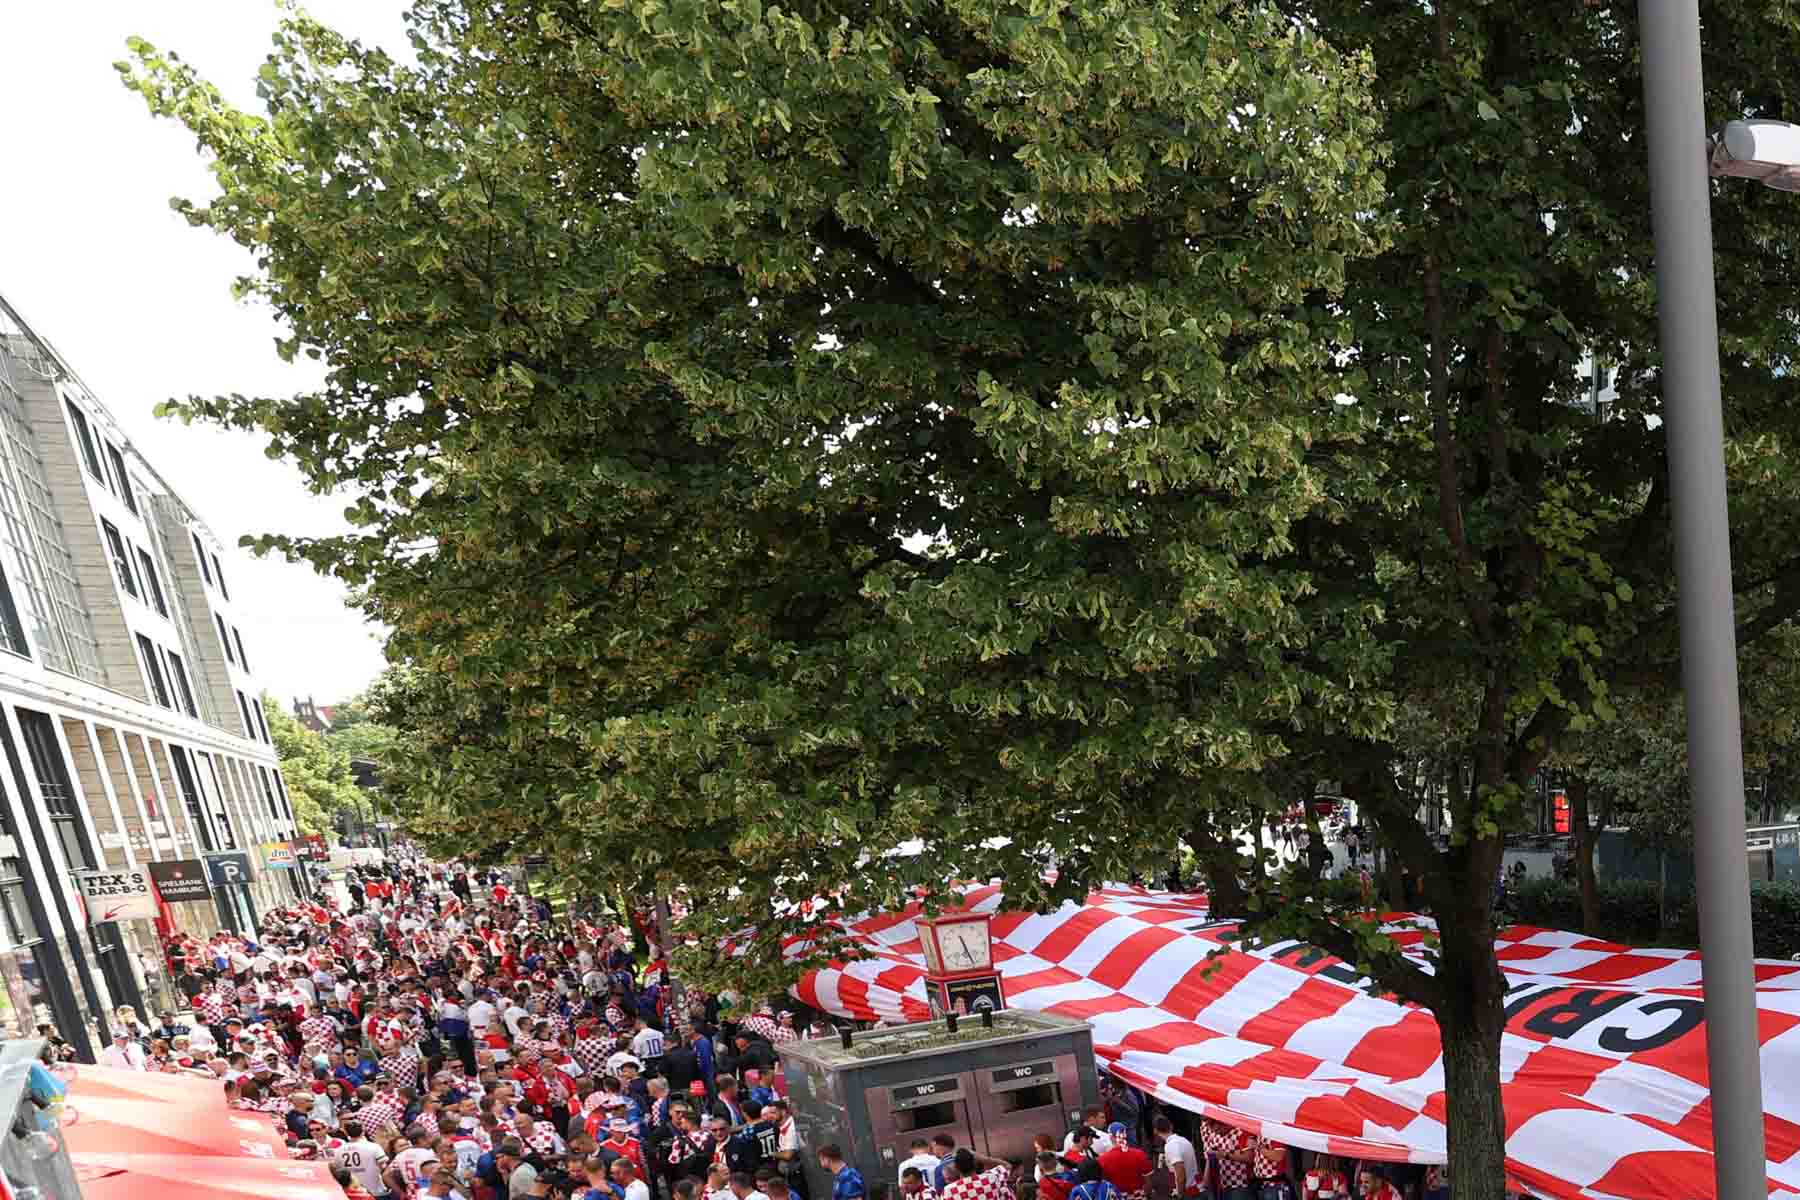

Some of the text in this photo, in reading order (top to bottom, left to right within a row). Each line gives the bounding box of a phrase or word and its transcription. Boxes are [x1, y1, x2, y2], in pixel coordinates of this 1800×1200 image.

[271, 848, 288, 859] dm
[84, 872, 145, 887] TEX'S
[157, 878, 205, 889] SPIELBANK
[87, 884, 147, 897] BAR-B-Q
[160, 885, 206, 897] HAMBURG
[646, 1038, 662, 1056] 10
[1013, 1066, 1033, 1077] WC
[916, 1083, 936, 1096] WC
[342, 1151, 361, 1168] 20
